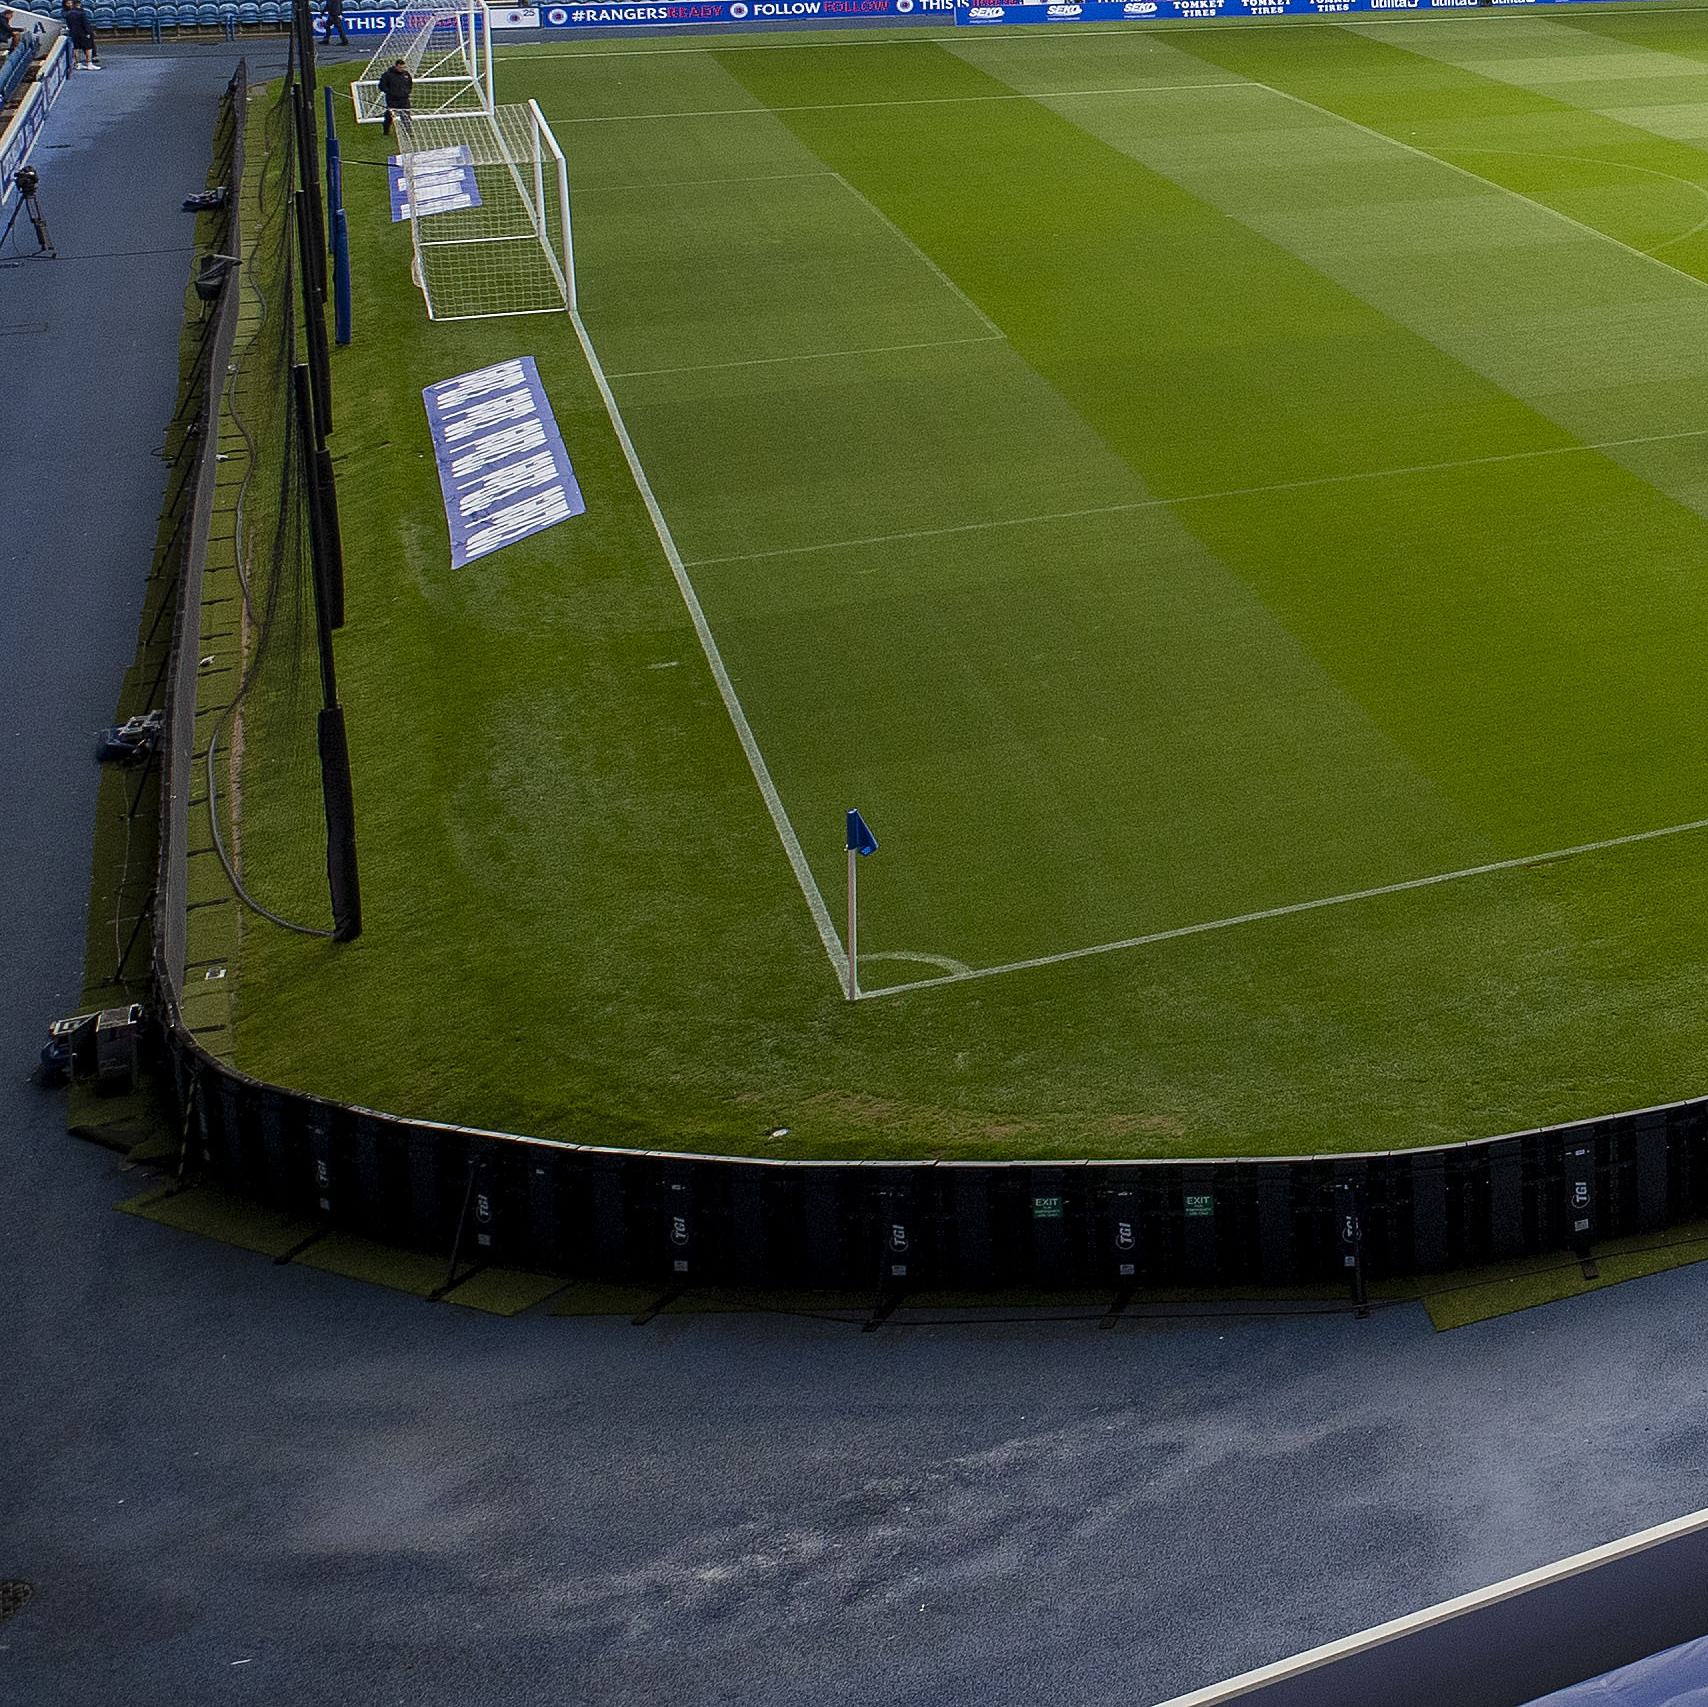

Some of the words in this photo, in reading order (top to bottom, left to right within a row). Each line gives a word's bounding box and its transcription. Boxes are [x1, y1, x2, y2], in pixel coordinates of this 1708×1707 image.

[753, 2, 820, 17] FOLLOW
[1047, 4, 1081, 16] SEKO
[1123, 2, 1156, 14] SEKO
[1173, 0, 1224, 9] TOMKET
[1250, 6, 1284, 15] TIRES
[1317, 3, 1350, 12] TIRES
[523, 9, 535, 17] 25
[572, 5, 723, 22] #RANGERSREADY
[969, 6, 1003, 18] SEKO
[1182, 9, 1216, 17] TIRES
[345, 17, 386, 30] THIS
[391, 16, 405, 29] IS
[1576, 1181, 1587, 1204] TGI
[478, 1194, 489, 1217] TGI
[1035, 1198, 1059, 1207] EXIT
[1187, 1196, 1210, 1205] EXIT
[674, 1217, 685, 1240] TGI
[1119, 1223, 1132, 1244] TGI
[893, 1225, 905, 1247] TGI
